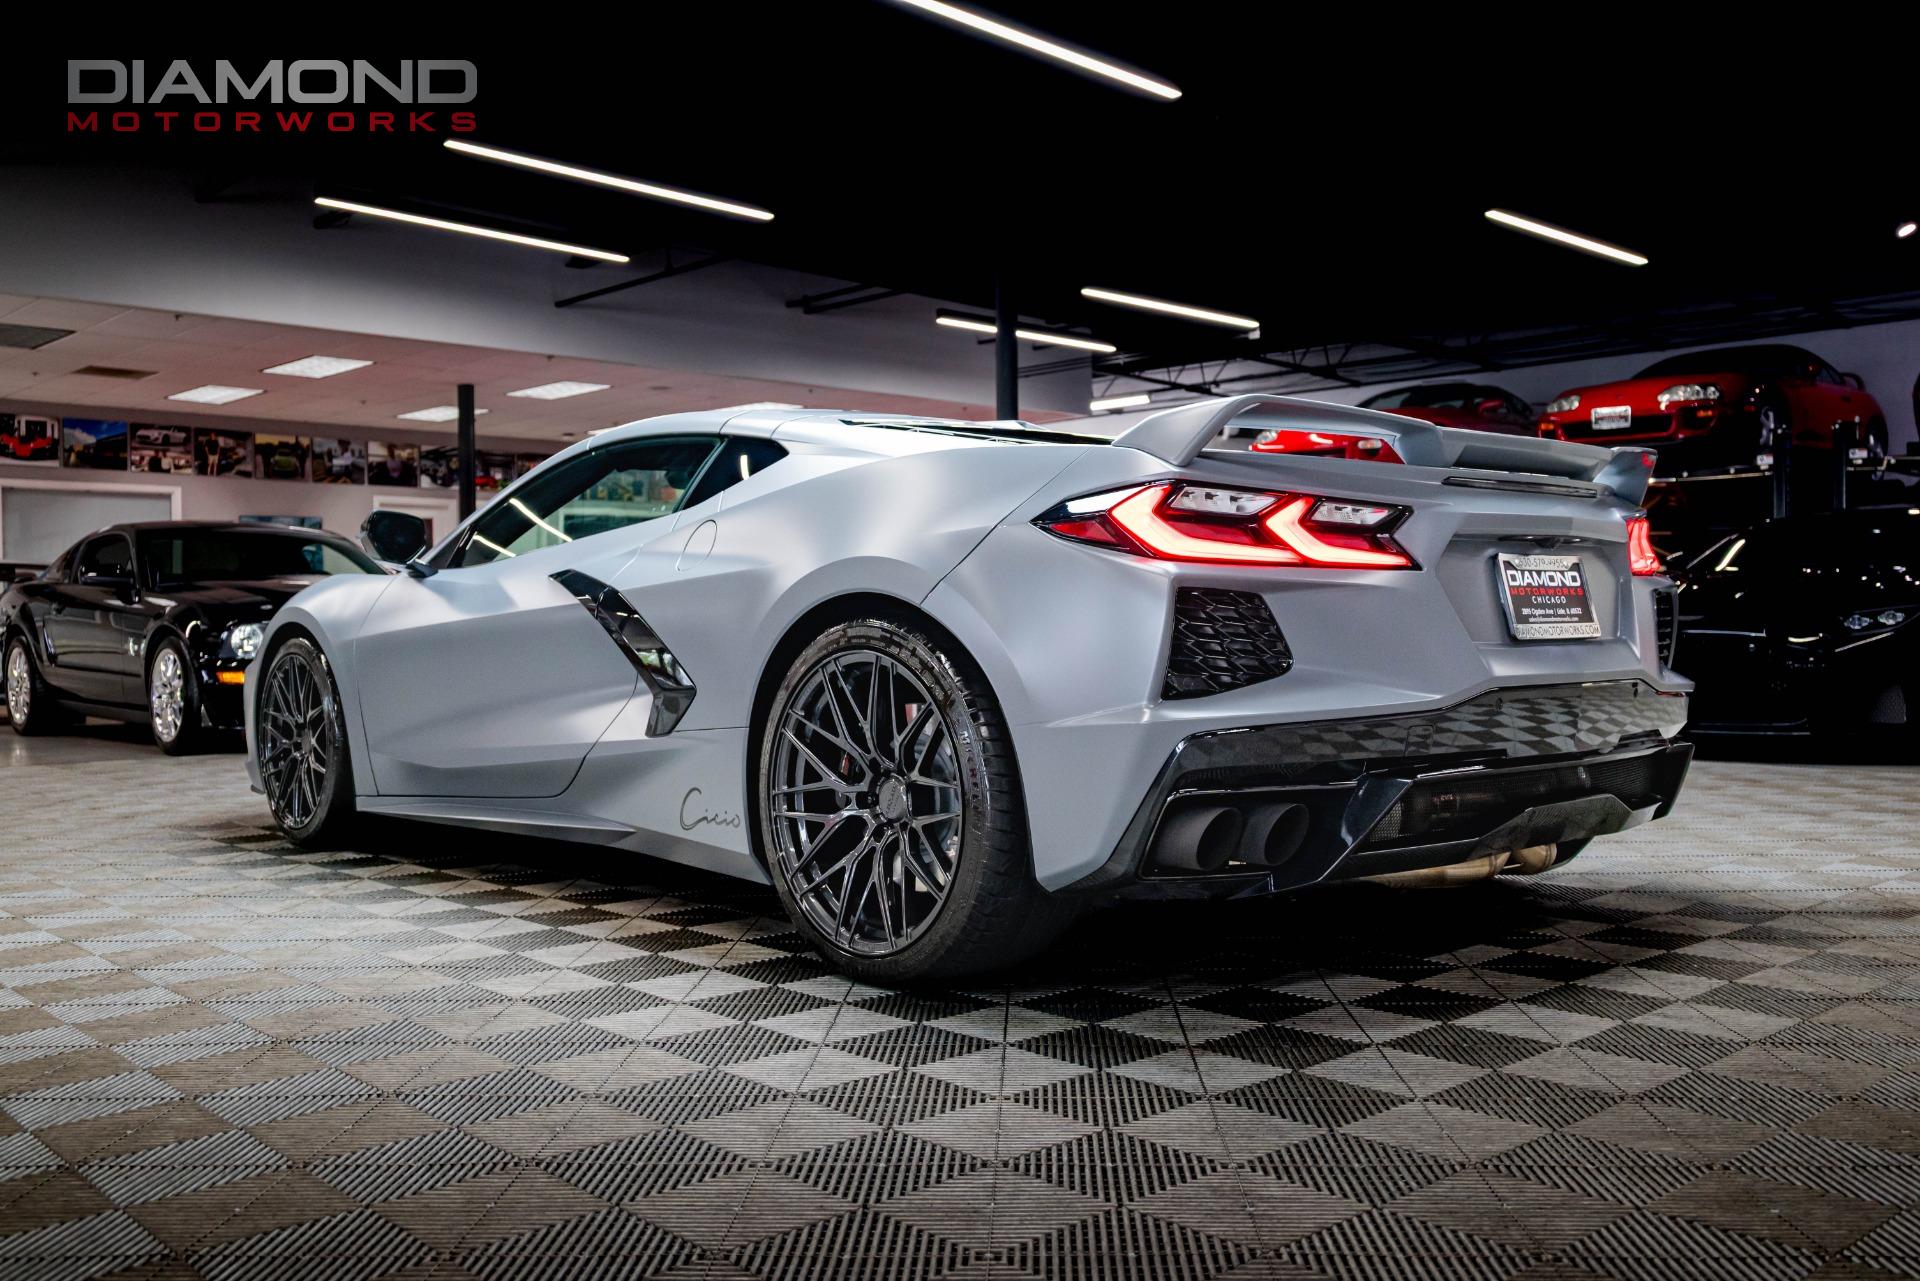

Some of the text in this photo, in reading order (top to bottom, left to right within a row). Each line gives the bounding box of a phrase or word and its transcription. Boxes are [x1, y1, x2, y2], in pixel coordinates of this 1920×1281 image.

[1506, 570, 1581, 587] DIAMOND
[1509, 587, 1584, 596] MOTORWORKS
[1532, 596, 1566, 604] CHICAGO
